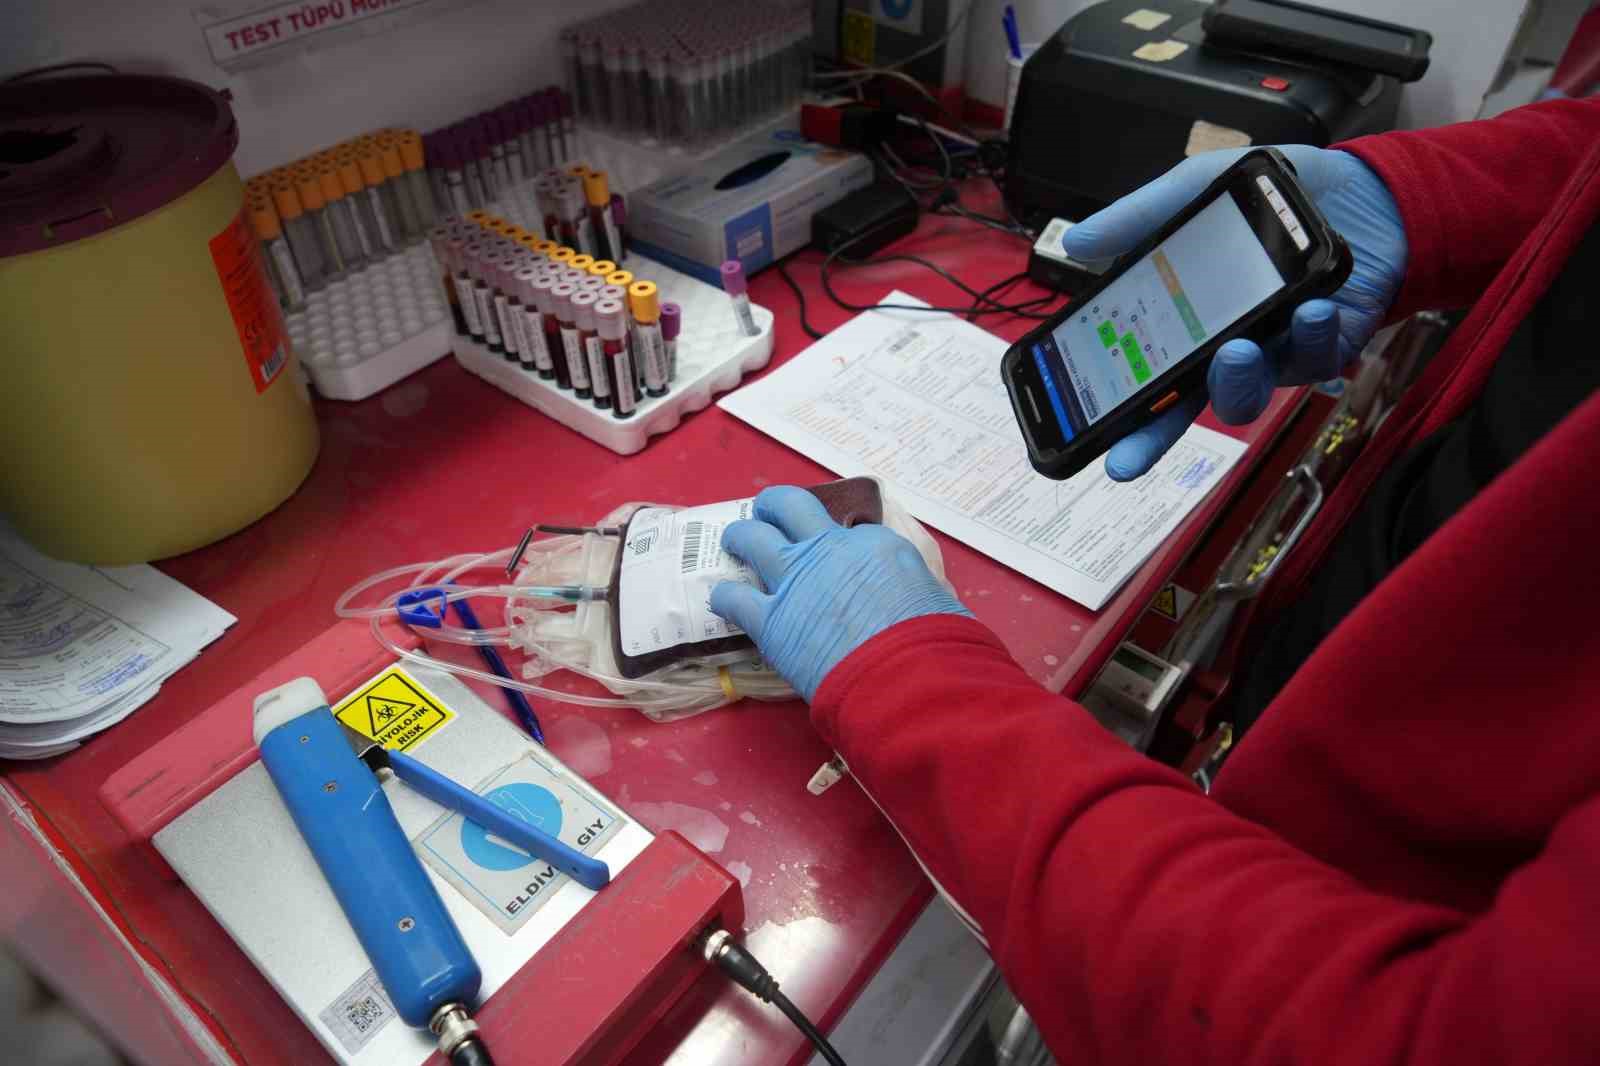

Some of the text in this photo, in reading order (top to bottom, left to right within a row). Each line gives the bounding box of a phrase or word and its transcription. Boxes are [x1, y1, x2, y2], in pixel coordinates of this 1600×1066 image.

[224, 19, 281, 51] TEST
[286, 0, 344, 32] TÜPÜ
[505, 817, 604, 914] ELDİV GİY
